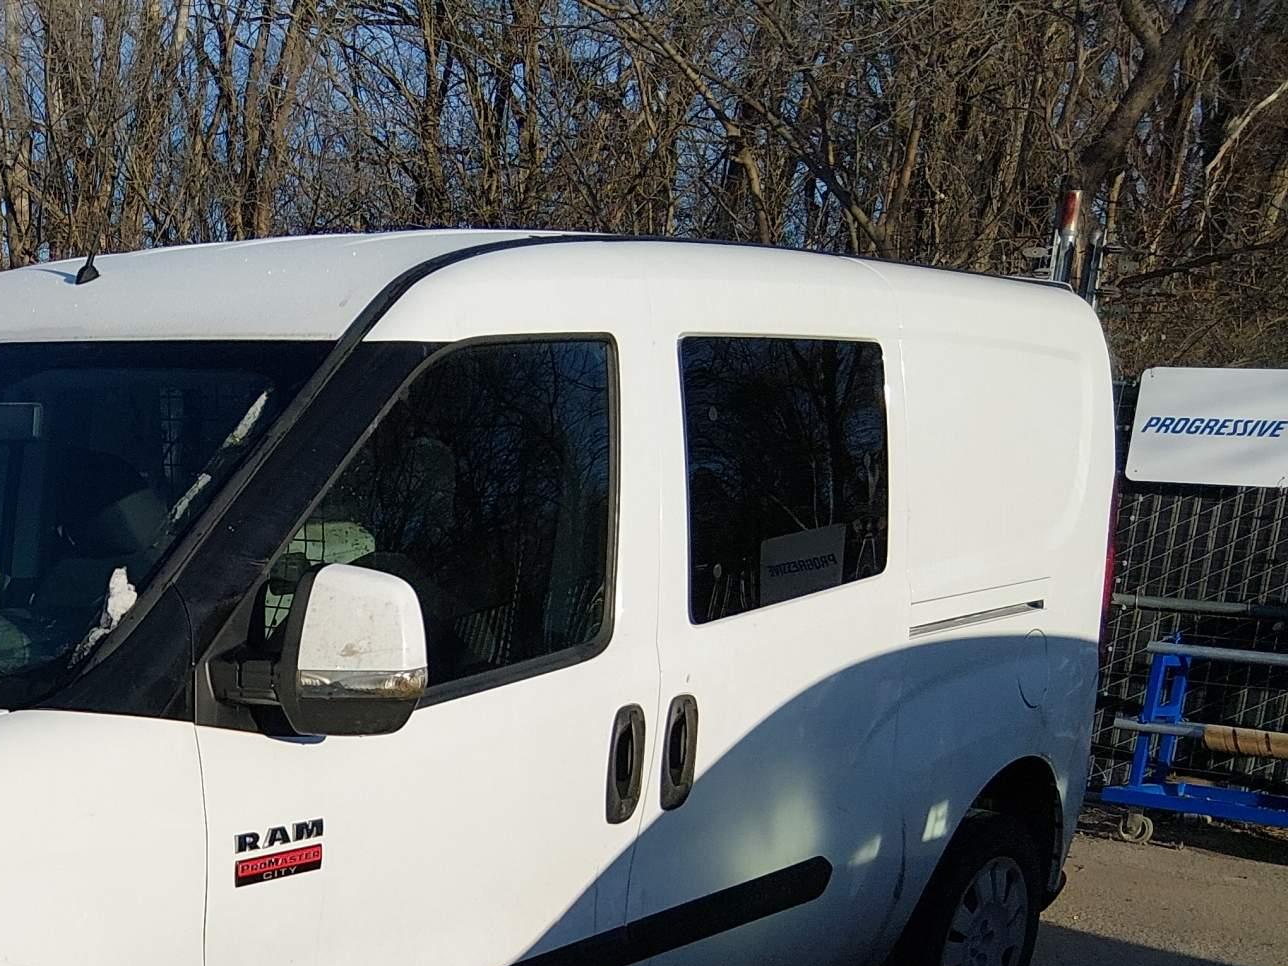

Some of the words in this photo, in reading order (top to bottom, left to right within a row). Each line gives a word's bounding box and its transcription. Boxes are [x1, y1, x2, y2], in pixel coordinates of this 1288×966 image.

[1141, 416, 1288, 438] PROGRESSIVE
[234, 818, 323, 854] RAM
[263, 866, 298, 880] CITY
